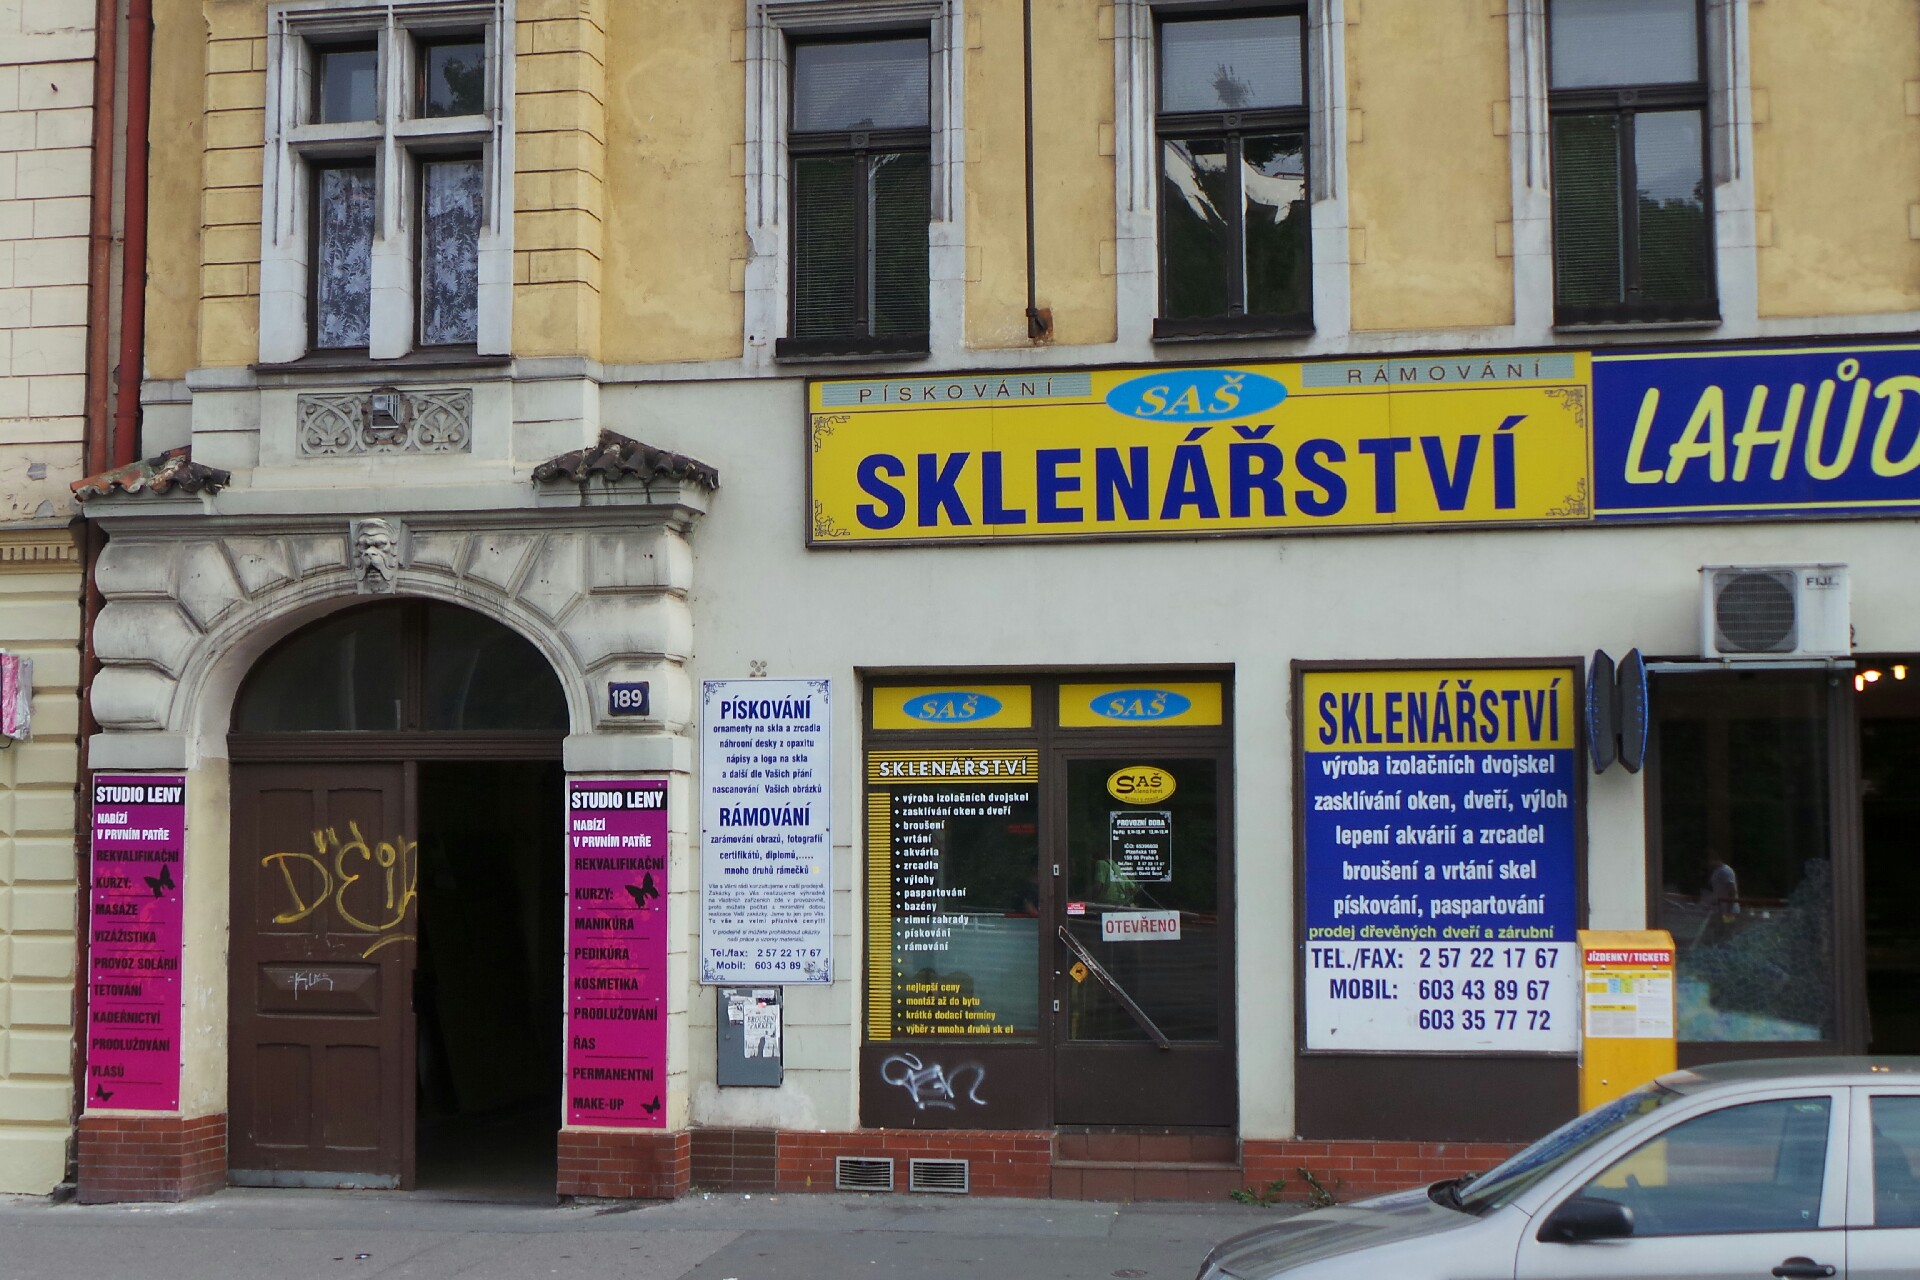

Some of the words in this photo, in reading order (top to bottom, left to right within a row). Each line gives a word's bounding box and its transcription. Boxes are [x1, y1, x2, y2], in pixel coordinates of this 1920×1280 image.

[1347, 359, 1540, 383] RÁMOVÁNÍ
[858, 377, 1054, 402] PÍSKOVÁNÍ
[1134, 374, 1244, 415] SAŠ
[855, 414, 1528, 530] SKLENÁŘSTVÍ
[612, 690, 642, 708] 189
[1105, 693, 1168, 717] SAŠ
[721, 695, 812, 719] PÍSKOVÁNÍ
[918, 695, 979, 719] SAŠ
[1318, 678, 1561, 745] SKLENÁŘSTVÍ
[713, 724, 752, 734] ornamenty
[768, 724, 783, 732] skla
[794, 724, 820, 732] zrcadla
[756, 739, 777, 749] desky
[787, 739, 814, 749] opaxitu
[727, 754, 750, 764] nápisy
[761, 755, 777, 764] loga
[792, 754, 807, 762] skla
[879, 756, 1027, 776] SKLENÁŘSTVÍ
[1322, 756, 1379, 779] výroba
[1386, 754, 1475, 775] izolačních
[1482, 754, 1555, 777] dvojskel
[730, 769, 748, 778] další
[751, 770, 762, 778] dle
[765, 769, 789, 778] Vašich
[793, 769, 812, 779] přání
[97, 787, 144, 803] STUDIO
[148, 787, 182, 803] LENY
[712, 784, 759, 793] nascanování
[765, 785, 789, 793] Vašich
[793, 784, 821, 793] obrázků
[571, 792, 622, 808] STUDIO
[627, 792, 663, 808] LENY
[903, 793, 934, 804] výroba
[937, 793, 985, 802] izolačních
[989, 793, 1028, 803] dvojskel
[1314, 790, 1401, 811] zasklívání
[1407, 792, 1456, 812] oken,
[1463, 789, 1513, 812] dveří,
[1521, 789, 1567, 812] výloh
[98, 811, 127, 824] NABÍZÍ
[720, 802, 811, 826] RÁMOVÁNÍ
[903, 806, 951, 816] zasklívání
[954, 807, 975, 815] oken
[987, 806, 1011, 815] dveří
[574, 818, 605, 830] NABÍZÍ
[903, 820, 945, 830] broušení
[98, 830, 104, 840] V
[105, 829, 140, 840] PRVNÍM
[142, 828, 169, 840] PATŘE
[574, 836, 580, 847] V
[582, 834, 619, 847] PRVNÍM
[622, 834, 651, 847] PATŘE
[711, 834, 753, 844] zarámování
[757, 835, 784, 844] obrazů,
[788, 834, 823, 844] fotografií
[903, 834, 932, 843] vrtání
[1335, 825, 1390, 848] lepení
[1395, 825, 1458, 844] akvárií
[1462, 829, 1473, 844] a
[1480, 825, 1544, 844] zrcadel
[97, 848, 179, 862] REKVALIFIKAČNÍ
[720, 850, 762, 860] certifikátů,
[903, 848, 939, 856] akvária
[575, 855, 664, 870] REKVALIFIKAČNÍ
[903, 861, 938, 870] zrcadla
[725, 866, 748, 874] mnoho
[753, 866, 773, 874] druhů
[777, 866, 808, 874] rámečků
[1342, 860, 1420, 880] broušení
[1424, 865, 1435, 880] a
[1442, 860, 1493, 880] vrtání
[1499, 859, 1536, 879] skel
[904, 875, 934, 885] výlohy
[575, 888, 613, 899] KURZY:
[905, 888, 966, 898] paspartování
[905, 902, 936, 911] bazény
[1333, 895, 1423, 918] pískování,
[1430, 894, 1545, 918] paspartování
[575, 916, 634, 930] MANIKÚRA
[905, 915, 930, 924] zimní
[932, 915, 969, 925] zahrady
[1106, 916, 1177, 933] OTEVŘENO
[95, 929, 156, 942] VIZÁŽISTIKA
[905, 928, 951, 938] pískování
[1309, 926, 1355, 941] prodej
[1360, 925, 1437, 940] dřevěných
[1442, 925, 1479, 939] dveří
[1485, 929, 1493, 938] a
[1498, 925, 1554, 939] zárubní
[575, 946, 629, 960] PEDIKÚRA
[711, 949, 748, 957] Tel./fax:
[758, 949, 762, 957] 2
[766, 949, 776, 957] 57
[781, 949, 791, 957] 22
[796, 949, 806, 957] 17
[810, 949, 821, 957] 67
[905, 942, 949, 951] rámování
[95, 958, 133, 969] PROVOZ
[138, 956, 177, 970] SOLÁRIÍ
[717, 961, 745, 969] Mobil:
[1311, 948, 1403, 971] TEL./FAX:
[1420, 948, 1431, 968] 2
[1439, 948, 1461, 968] 57
[1470, 948, 1493, 968] 22
[1503, 948, 1525, 968] 17
[1534, 948, 1558, 968] 67
[574, 978, 638, 990] KOSMETIKA
[906, 983, 938, 993] nejlepší
[941, 984, 960, 993] ceny
[1329, 979, 1398, 1000] MOBIL:
[1419, 980, 1454, 1000] 603
[1462, 980, 1485, 1000] 43
[1494, 980, 1518, 1000] 89
[1527, 980, 1550, 1000] 67
[906, 997, 935, 1005] montáž
[938, 997, 947, 1005] až
[949, 997, 959, 1005] do
[962, 997, 980, 1006] bytu
[574, 1005, 657, 1020] PRODLUŽOVÁNÍ
[906, 1010, 932, 1019] krátké
[935, 1010, 962, 1019] dodací
[1419, 1009, 1454, 1030] 603
[1462, 1009, 1485, 1030] 35
[1494, 1009, 1517, 1030] 77
[1527, 1010, 1550, 1030] 72
[907, 1024, 928, 1034] výběr
[938, 1025, 964, 1033] mnoha
[93, 1037, 169, 1051] PRODLUŽOVÁNÍ
[573, 1035, 595, 1049] ŘAS
[573, 1066, 653, 1081] PERMANENTNÍ
[573, 1097, 624, 1110] MAKE-UP
